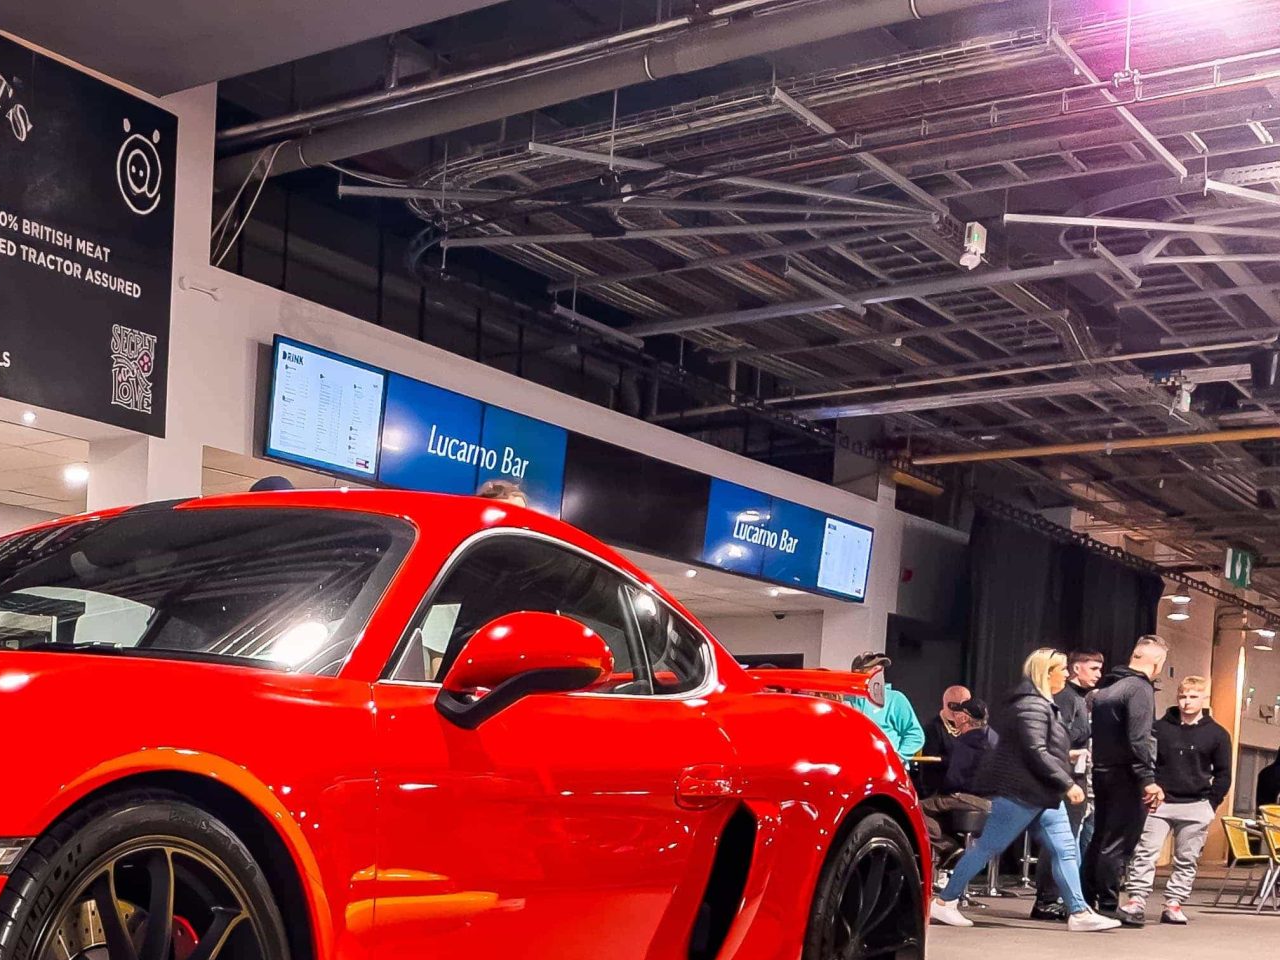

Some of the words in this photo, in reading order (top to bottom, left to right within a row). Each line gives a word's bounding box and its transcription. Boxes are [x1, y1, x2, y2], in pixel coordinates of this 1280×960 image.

[22, 219, 72, 250] BRITISH
[76, 238, 111, 262] MEAT
[20, 244, 81, 278] TRACTOR
[85, 268, 142, 298] ASSURED
[427, 424, 497, 470] Lucarno
[501, 446, 529, 479] Bar
[733, 518, 777, 548] Lucarno
[779, 529, 798, 553] Bar
